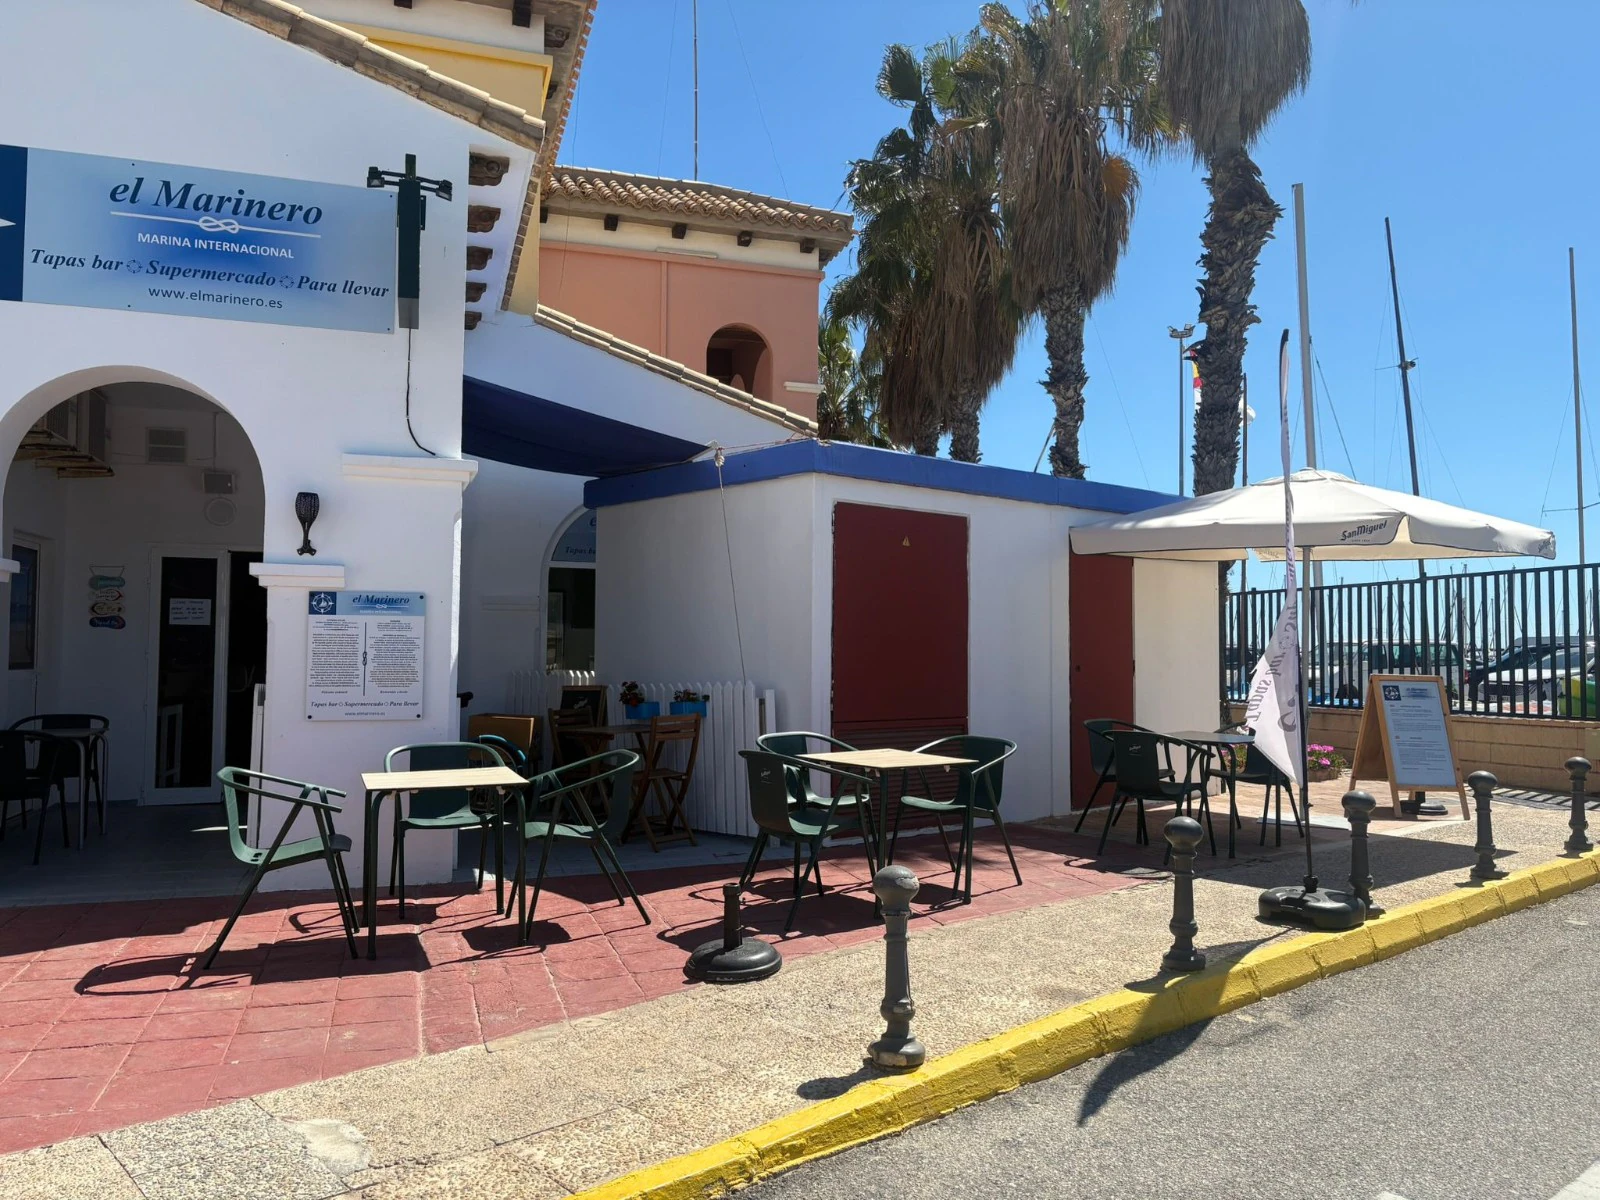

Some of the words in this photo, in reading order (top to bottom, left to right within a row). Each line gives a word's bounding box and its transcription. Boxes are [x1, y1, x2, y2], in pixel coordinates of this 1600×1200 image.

[109, 177, 145, 205] el
[154, 179, 324, 226] Marinero
[137, 232, 191, 249] MARINA
[194, 238, 294, 259] INTERNACIONAL
[31, 248, 86, 272] Tapas
[91, 250, 124, 273] bar
[145, 259, 277, 288] Supermercado
[296, 275, 338, 294] Para
[341, 279, 390, 298] llevar
[148, 286, 283, 310] www.elmarinero.es
[352, 594, 362, 604] el
[365, 594, 410, 605] Marinero
